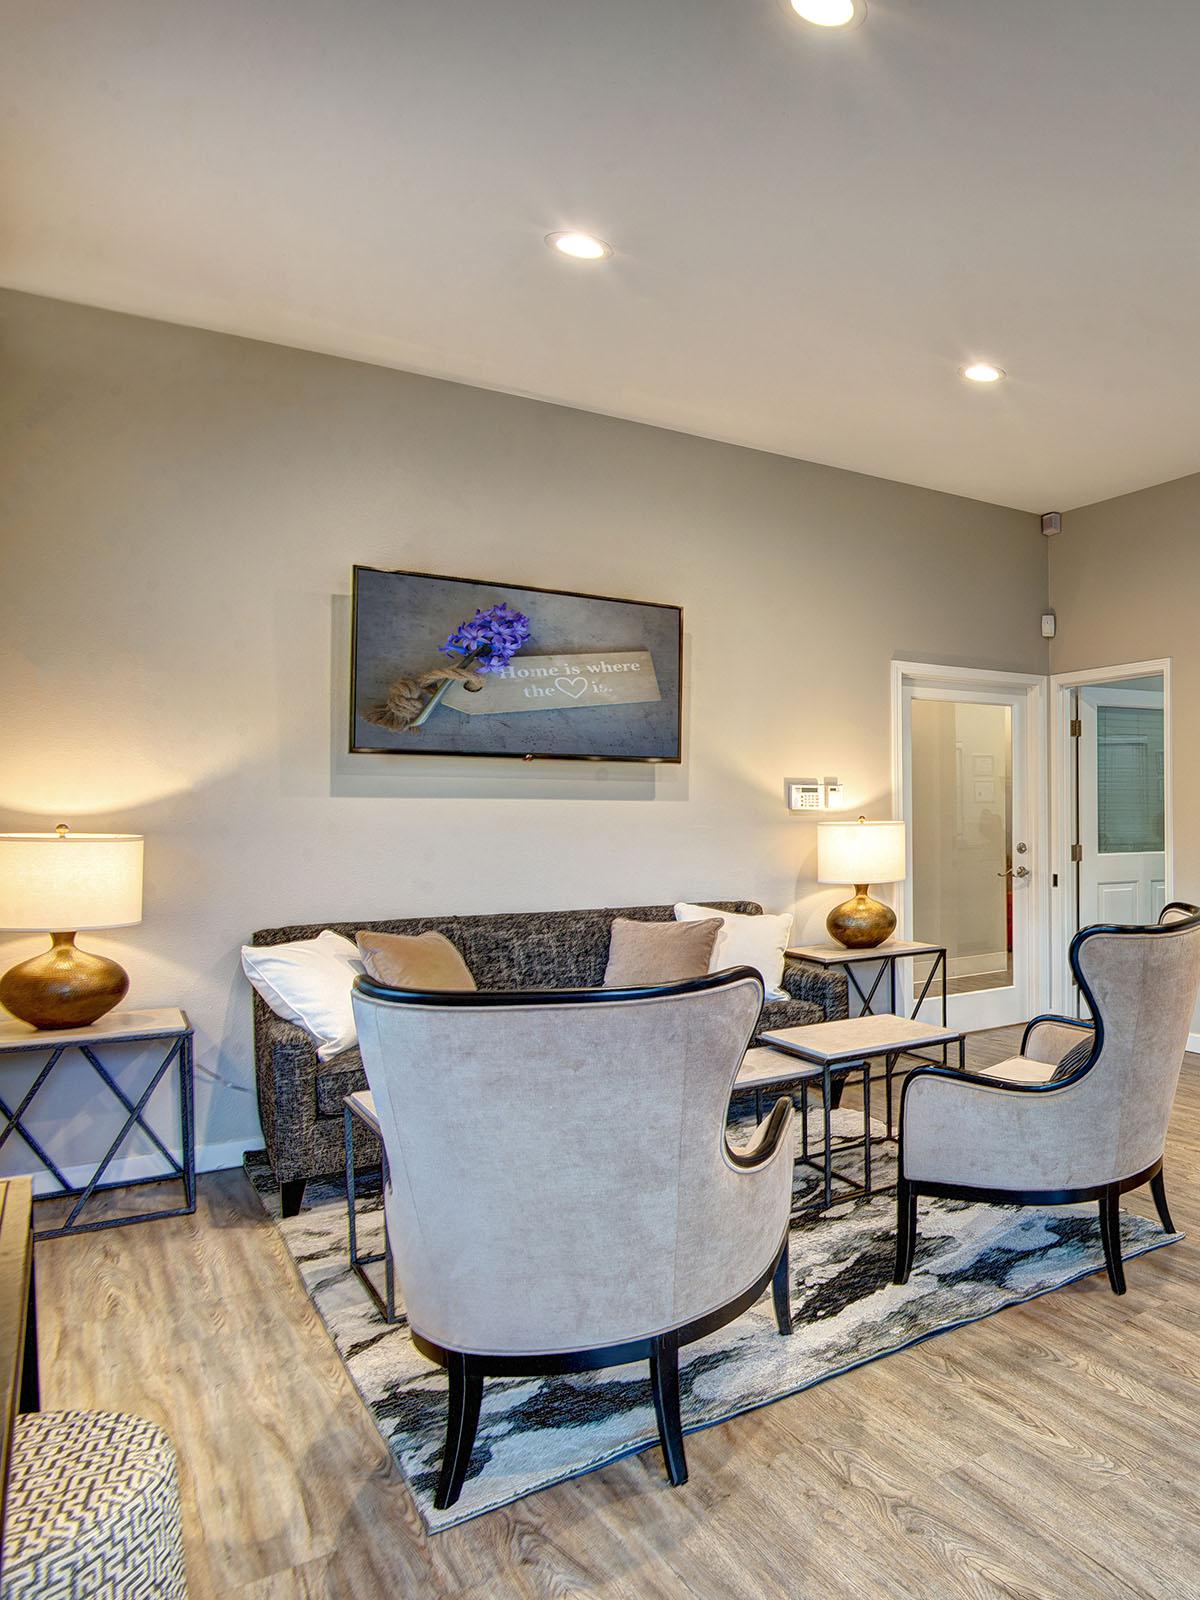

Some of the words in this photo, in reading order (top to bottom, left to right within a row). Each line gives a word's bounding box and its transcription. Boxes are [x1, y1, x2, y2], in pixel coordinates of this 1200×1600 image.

[500, 664, 560, 680] Home
[565, 663, 581, 676] is
[586, 660, 641, 674] where
[522, 684, 556, 698] the
